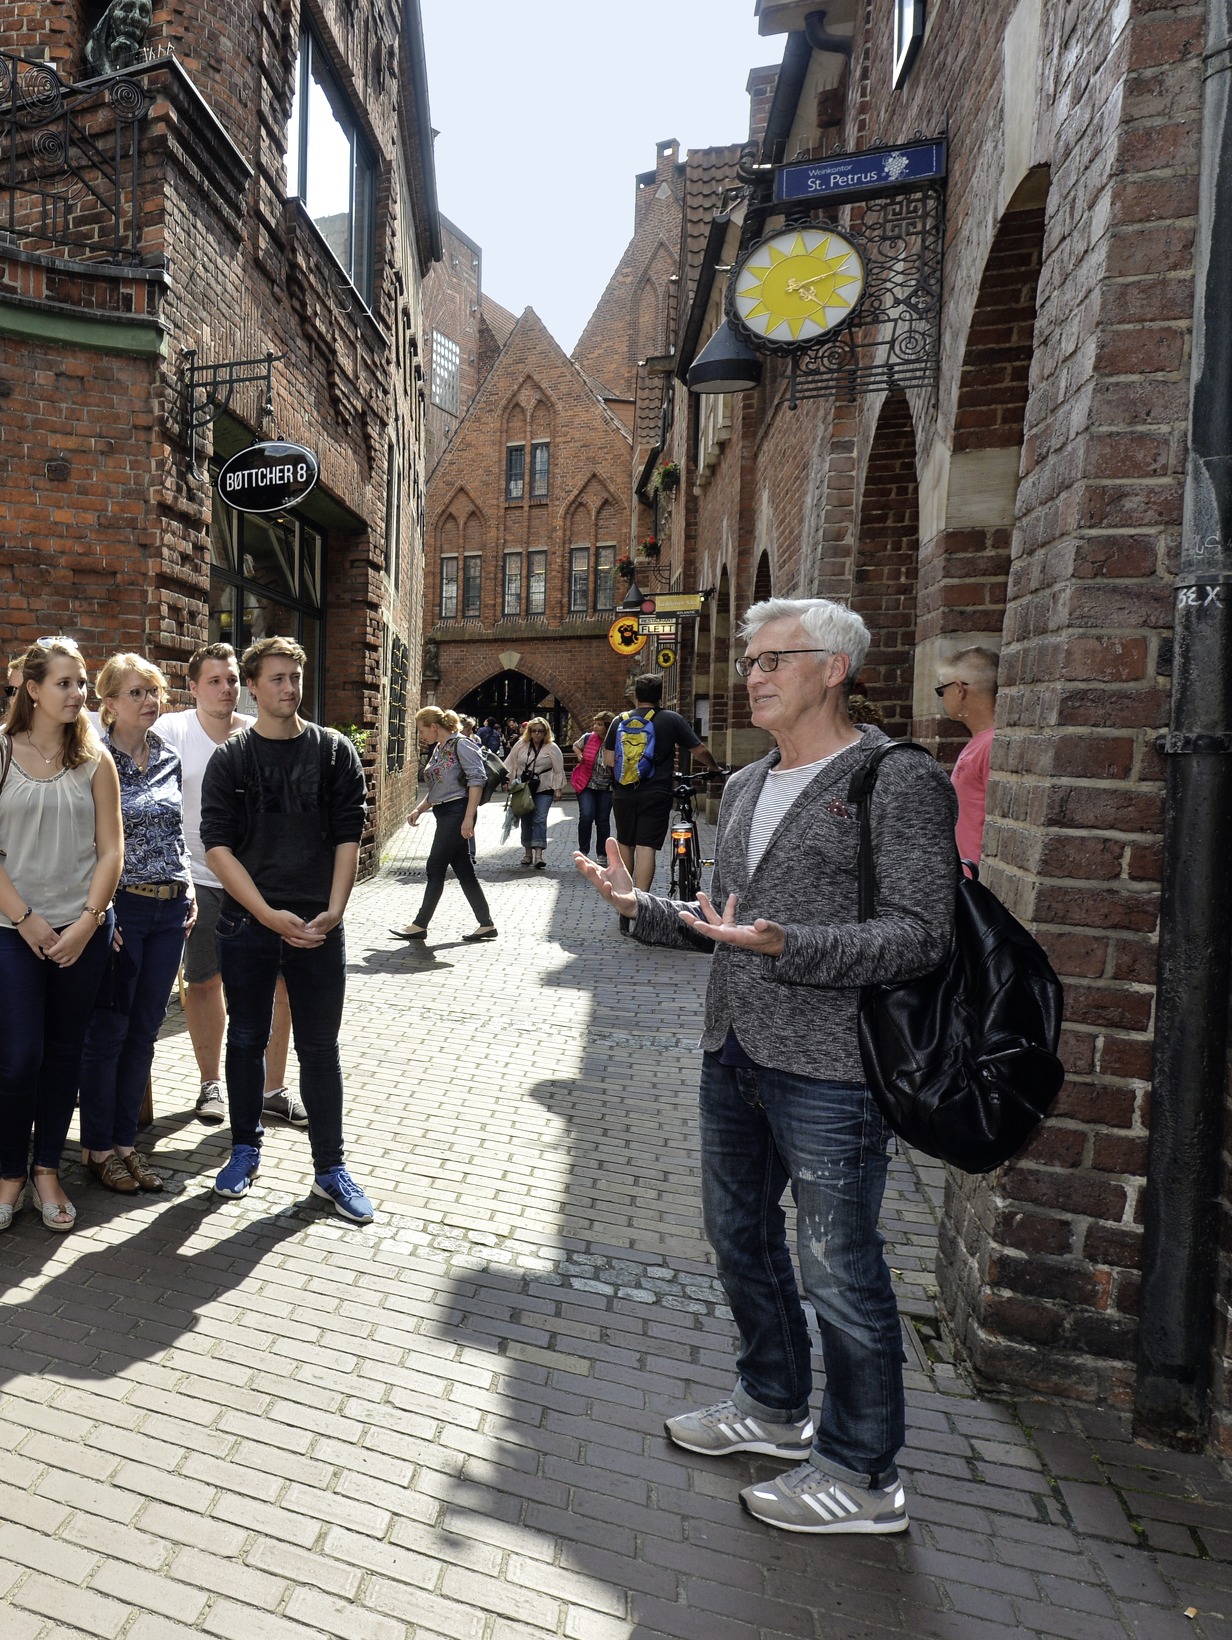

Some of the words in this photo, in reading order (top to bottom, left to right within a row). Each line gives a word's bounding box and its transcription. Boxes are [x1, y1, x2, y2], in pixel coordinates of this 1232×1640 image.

[808, 164, 853, 177] Weinkontor
[808, 178, 826, 191] St.
[830, 171, 878, 188] Petrus
[226, 464, 294, 492] BØTTCHER
[297, 463, 307, 482] 8
[1178, 586, 1223, 608] SEX
[641, 625, 674, 633] FLETT
